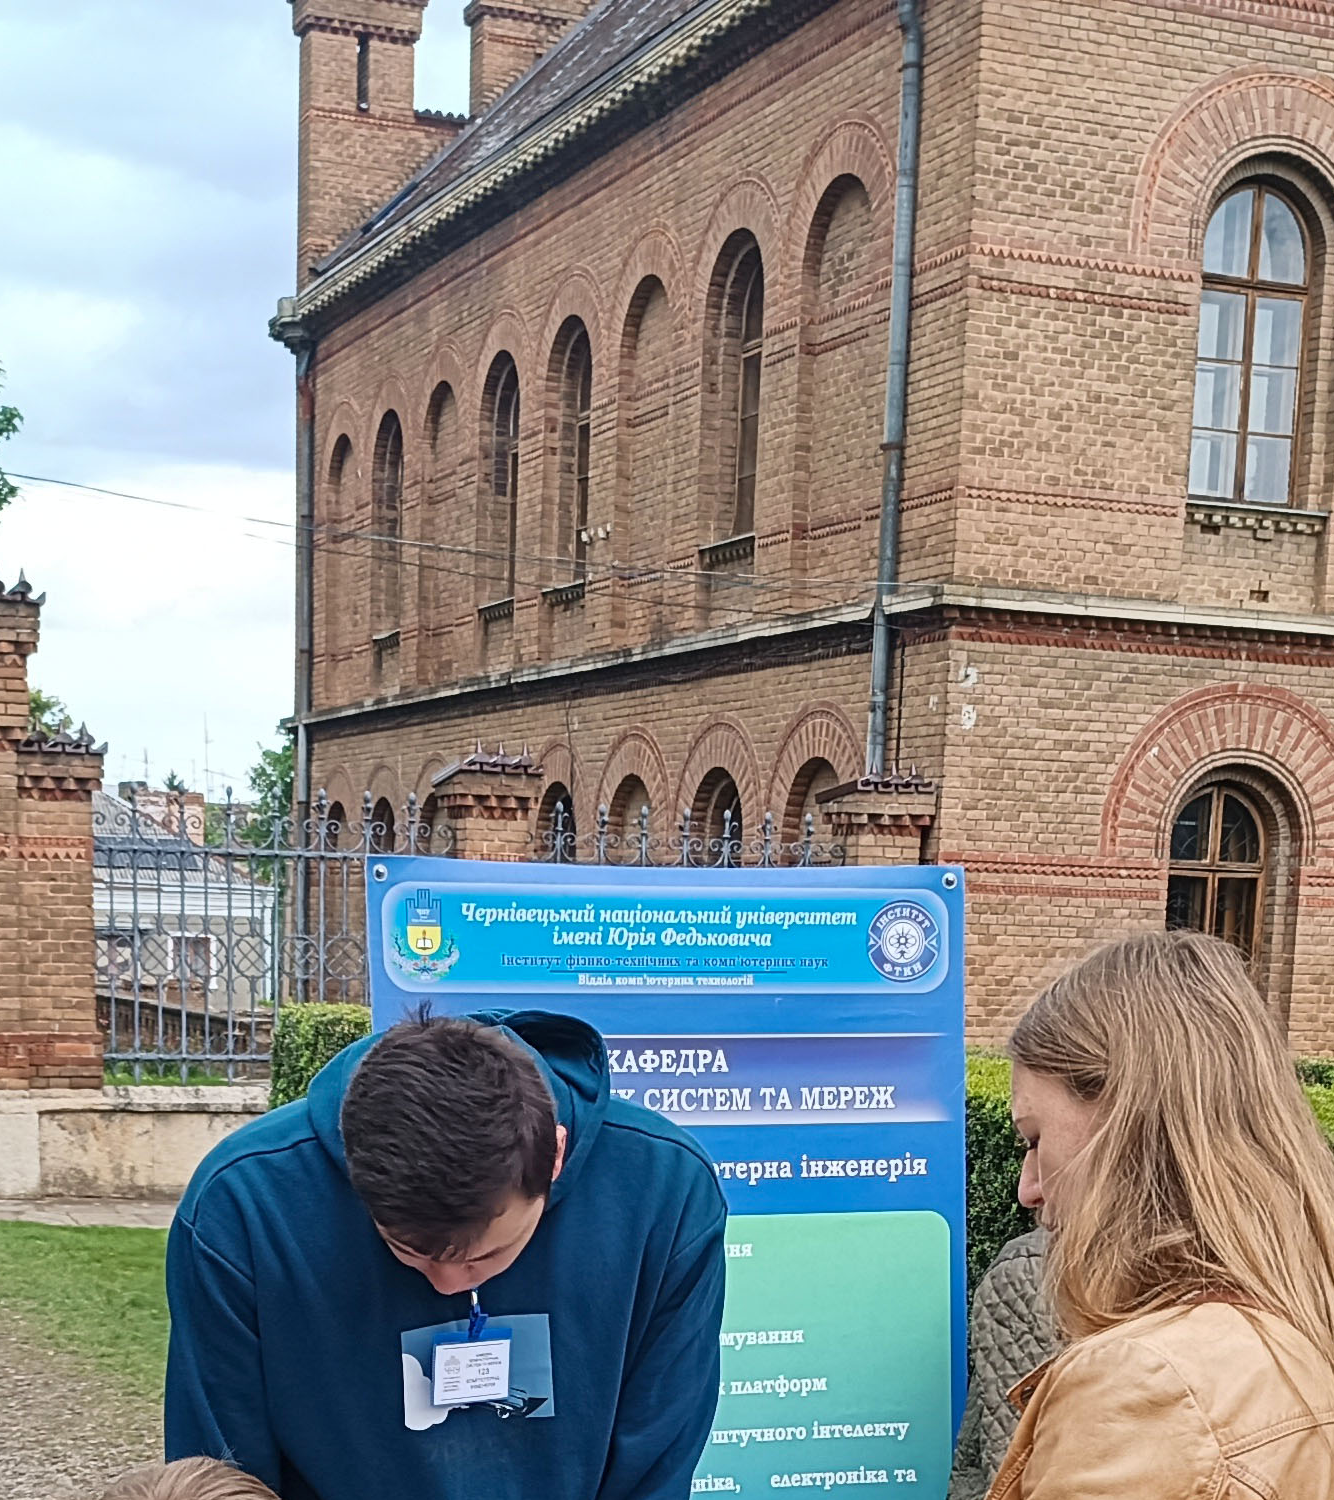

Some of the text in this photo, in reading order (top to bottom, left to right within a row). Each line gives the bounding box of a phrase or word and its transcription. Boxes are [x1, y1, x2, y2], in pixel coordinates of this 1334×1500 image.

[461, 901, 857, 930] Чернівецький національний університет
[875, 907, 931, 930] ІНСТИТУТ
[552, 925, 773, 951] імені Юрія Федьковича
[500, 953, 829, 972] Інститут фізико-технічних та комп'ютерних наук
[882, 960, 923, 977] ФТКН
[577, 974, 755, 988] Відділ комп'ютерних технологій
[643, 1087, 752, 1112] СИСТЕМ
[759, 1086, 793, 1111] ТА
[799, 1085, 896, 1110] МЕРЕЖ
[800, 1151, 928, 1183] інженерія
[730, 1375, 828, 1397] платформ
[711, 1419, 910, 1448] штучного інтелекту
[770, 1465, 889, 1491] електроніка
[893, 1468, 918, 1485] та
